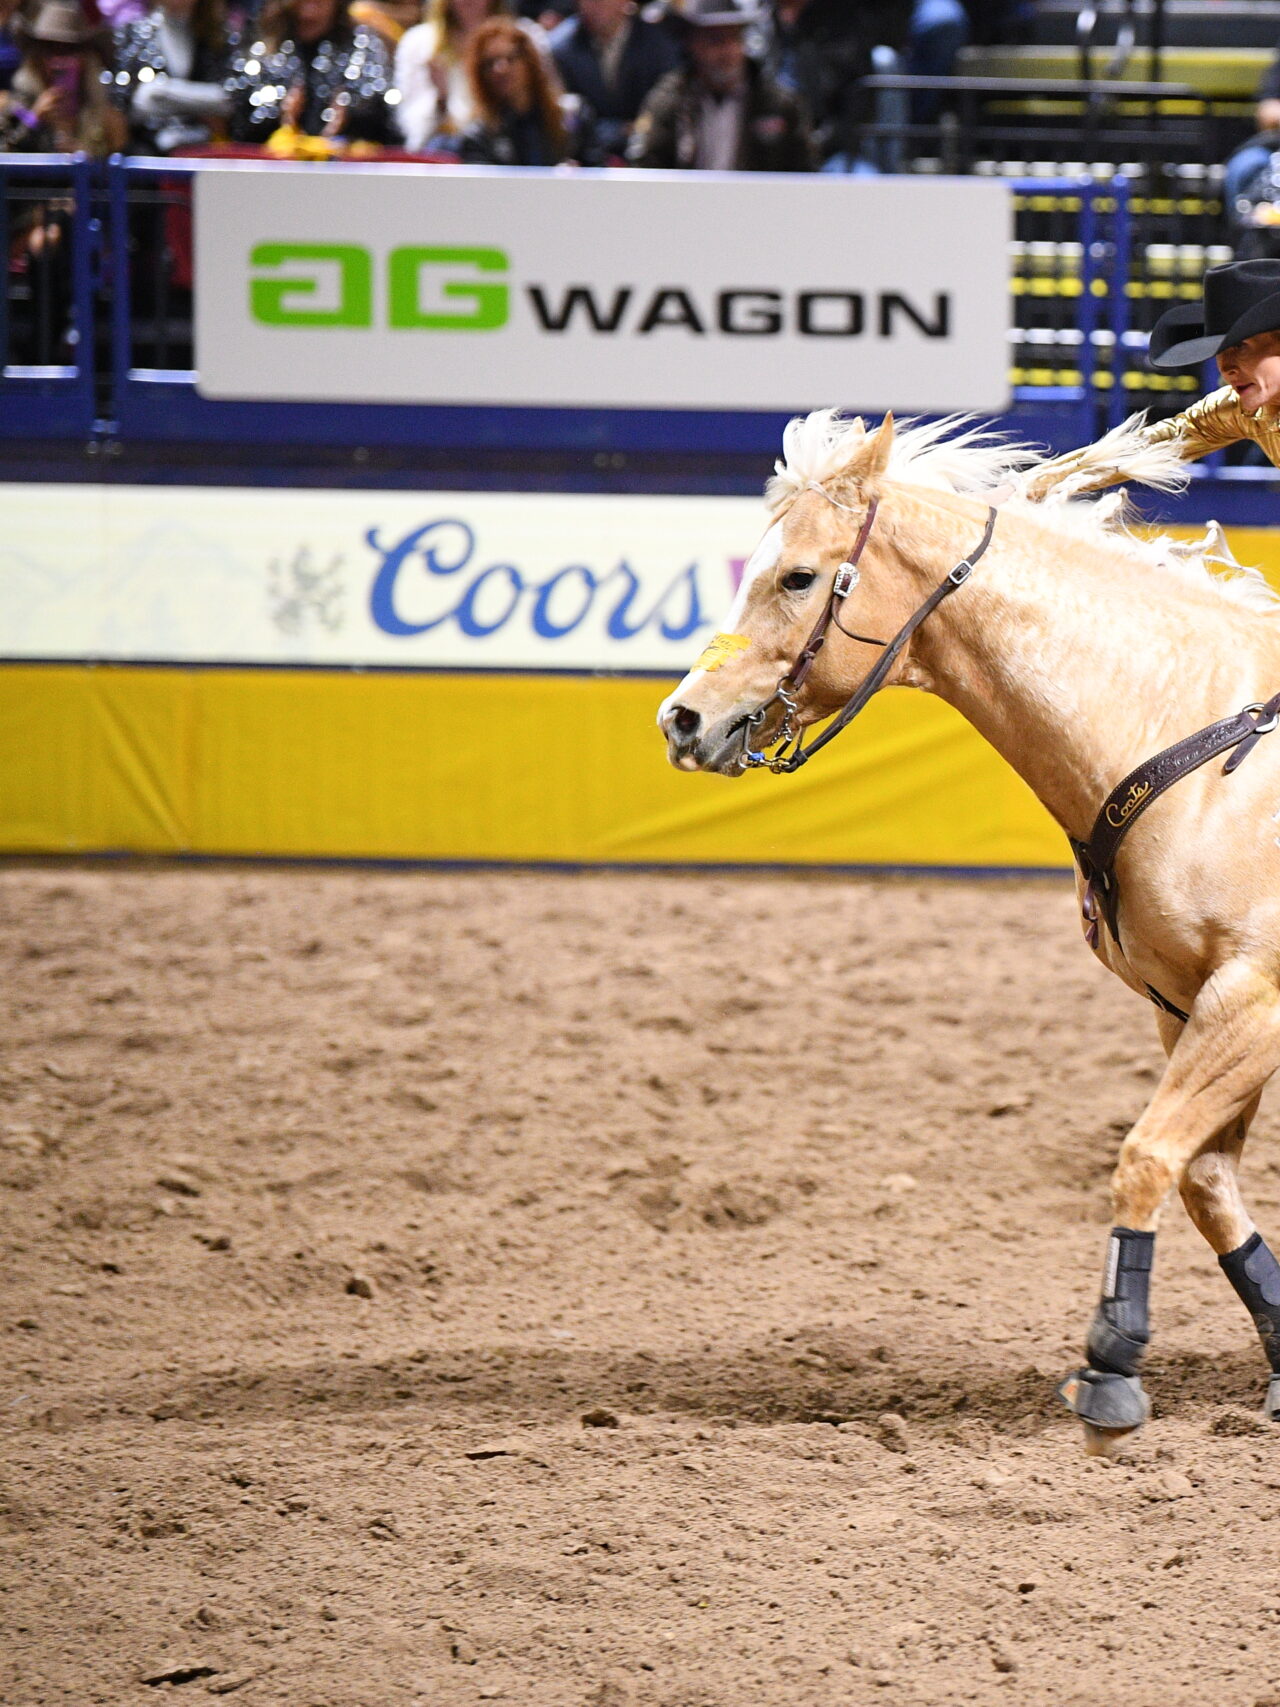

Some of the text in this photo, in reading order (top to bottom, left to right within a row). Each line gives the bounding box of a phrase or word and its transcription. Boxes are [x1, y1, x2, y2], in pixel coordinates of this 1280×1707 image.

[527, 285, 950, 338] WAGON
[365, 518, 712, 641] Coors
[1105, 781, 1154, 827] Coats
